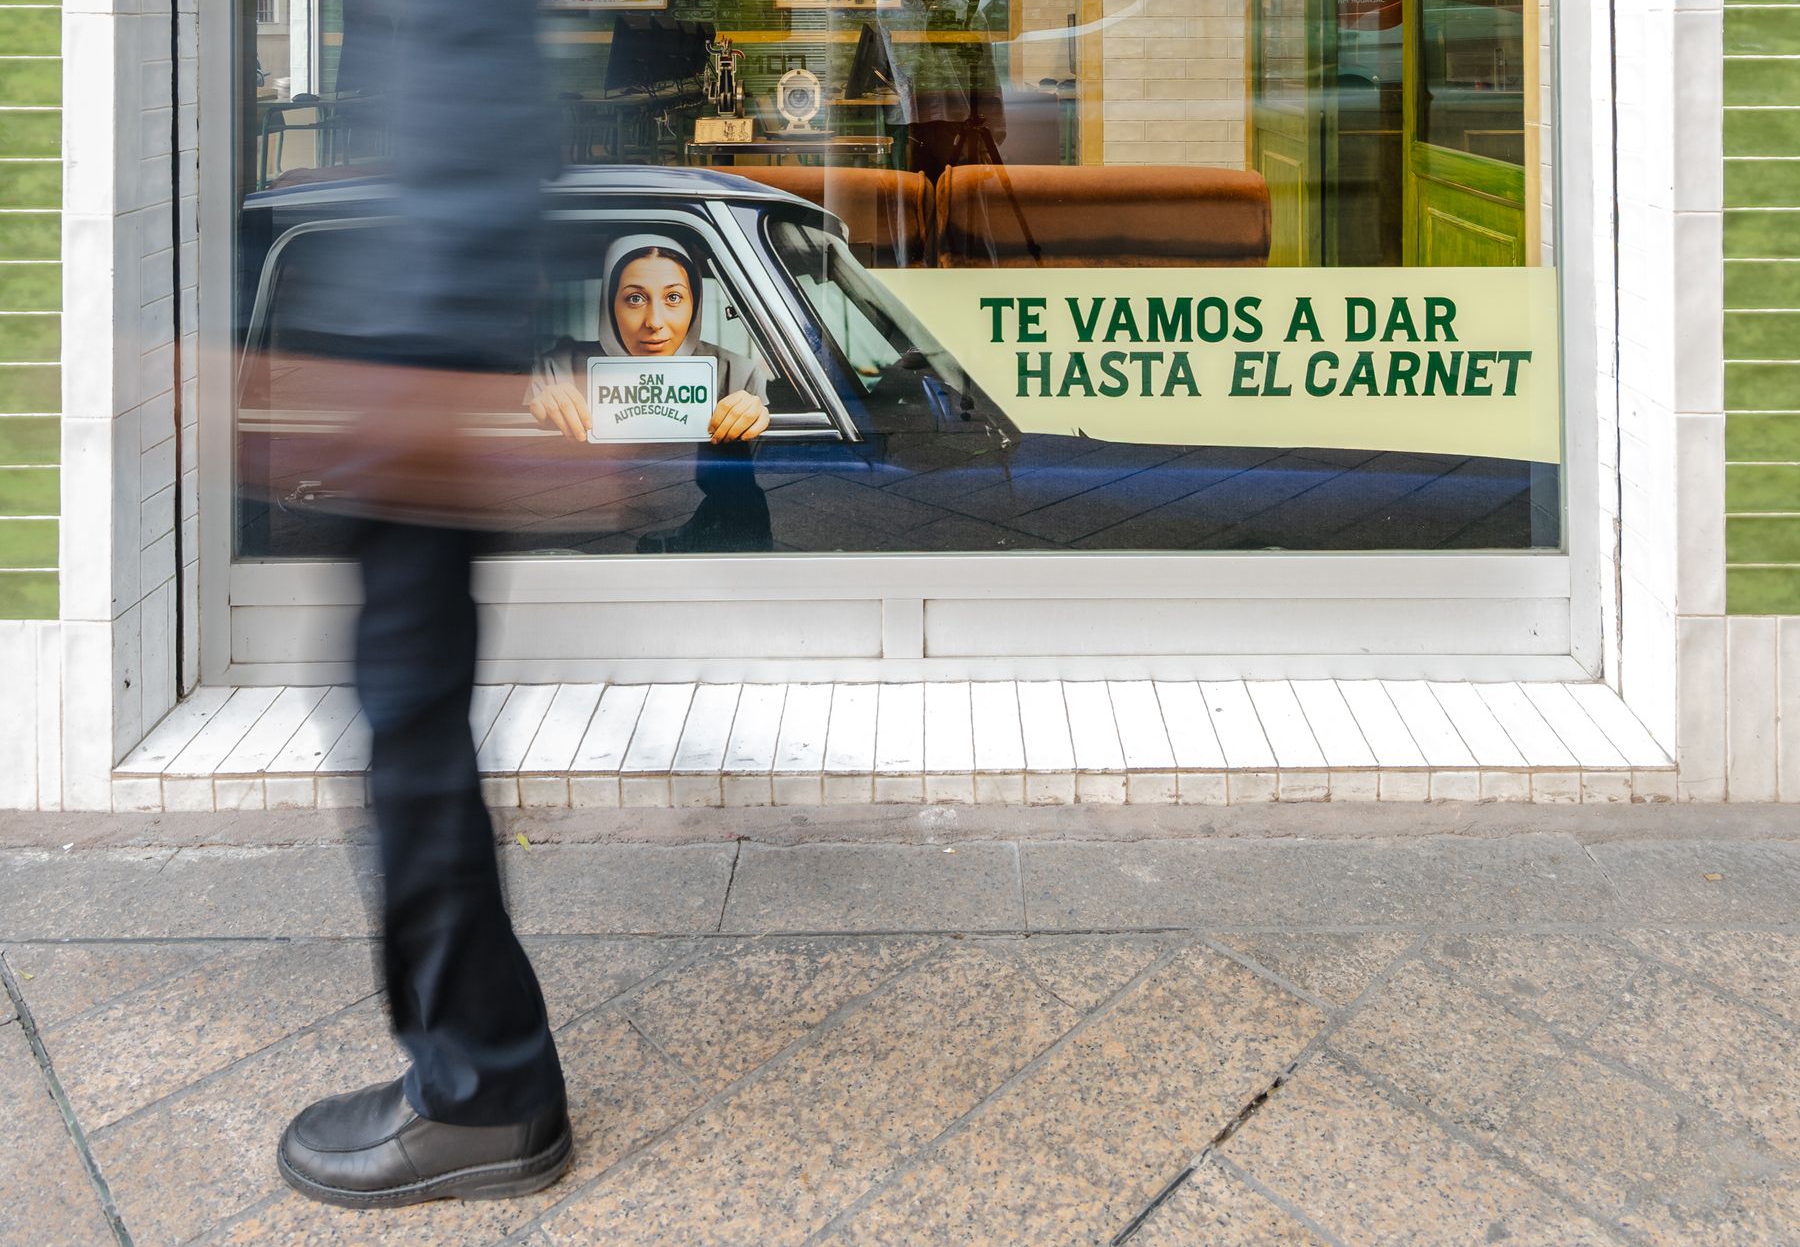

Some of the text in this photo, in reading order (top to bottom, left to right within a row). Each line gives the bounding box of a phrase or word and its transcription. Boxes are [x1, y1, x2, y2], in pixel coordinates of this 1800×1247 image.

[980, 296, 1459, 344] TE VAMOS A DAR
[639, 373, 664, 385] SAN
[1016, 351, 1533, 397] HASTA EL CARNET
[598, 385, 708, 404] PANCRACIO
[614, 404, 688, 425] AUTOESCUELA
